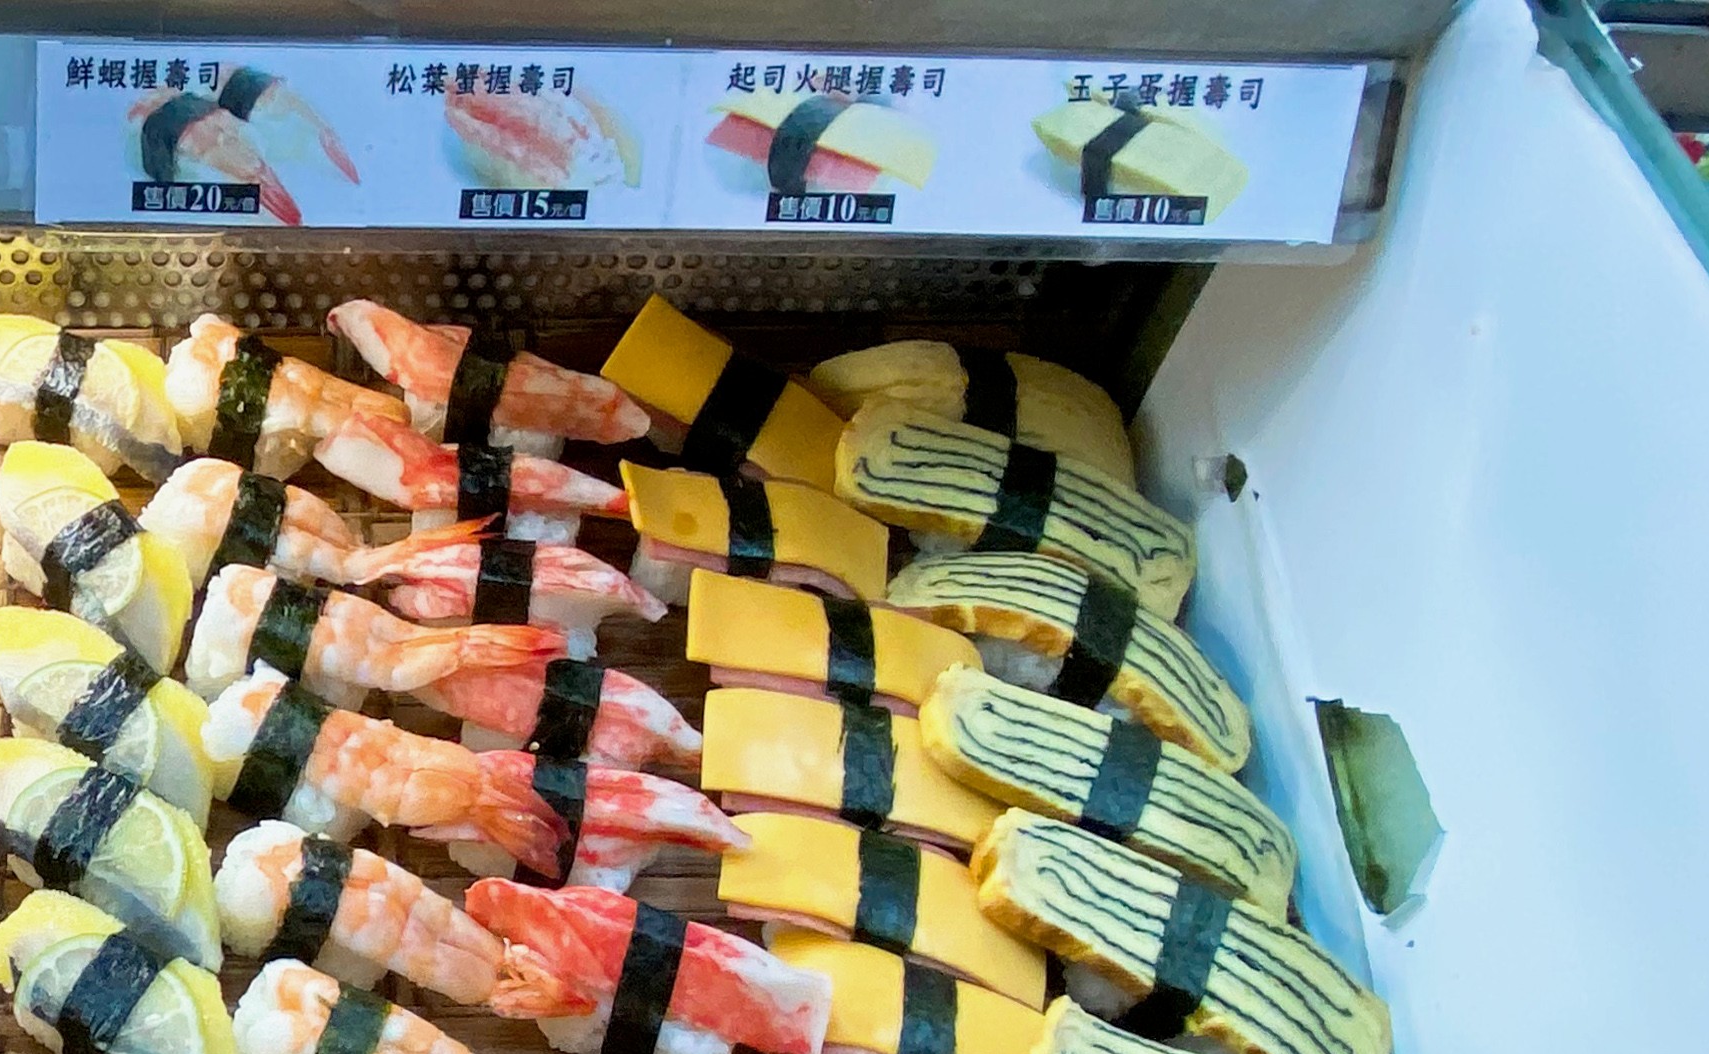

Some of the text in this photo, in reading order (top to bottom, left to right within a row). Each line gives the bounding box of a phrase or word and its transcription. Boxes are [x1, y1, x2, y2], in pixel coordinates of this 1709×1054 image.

[65, 56, 221, 92] 鮮蝦握壽司
[386, 62, 576, 97] 松葉蟹握壽司
[726, 62, 947, 98] 起司火腿握壽司
[1068, 72, 1265, 110] 玉子蛋握壽司
